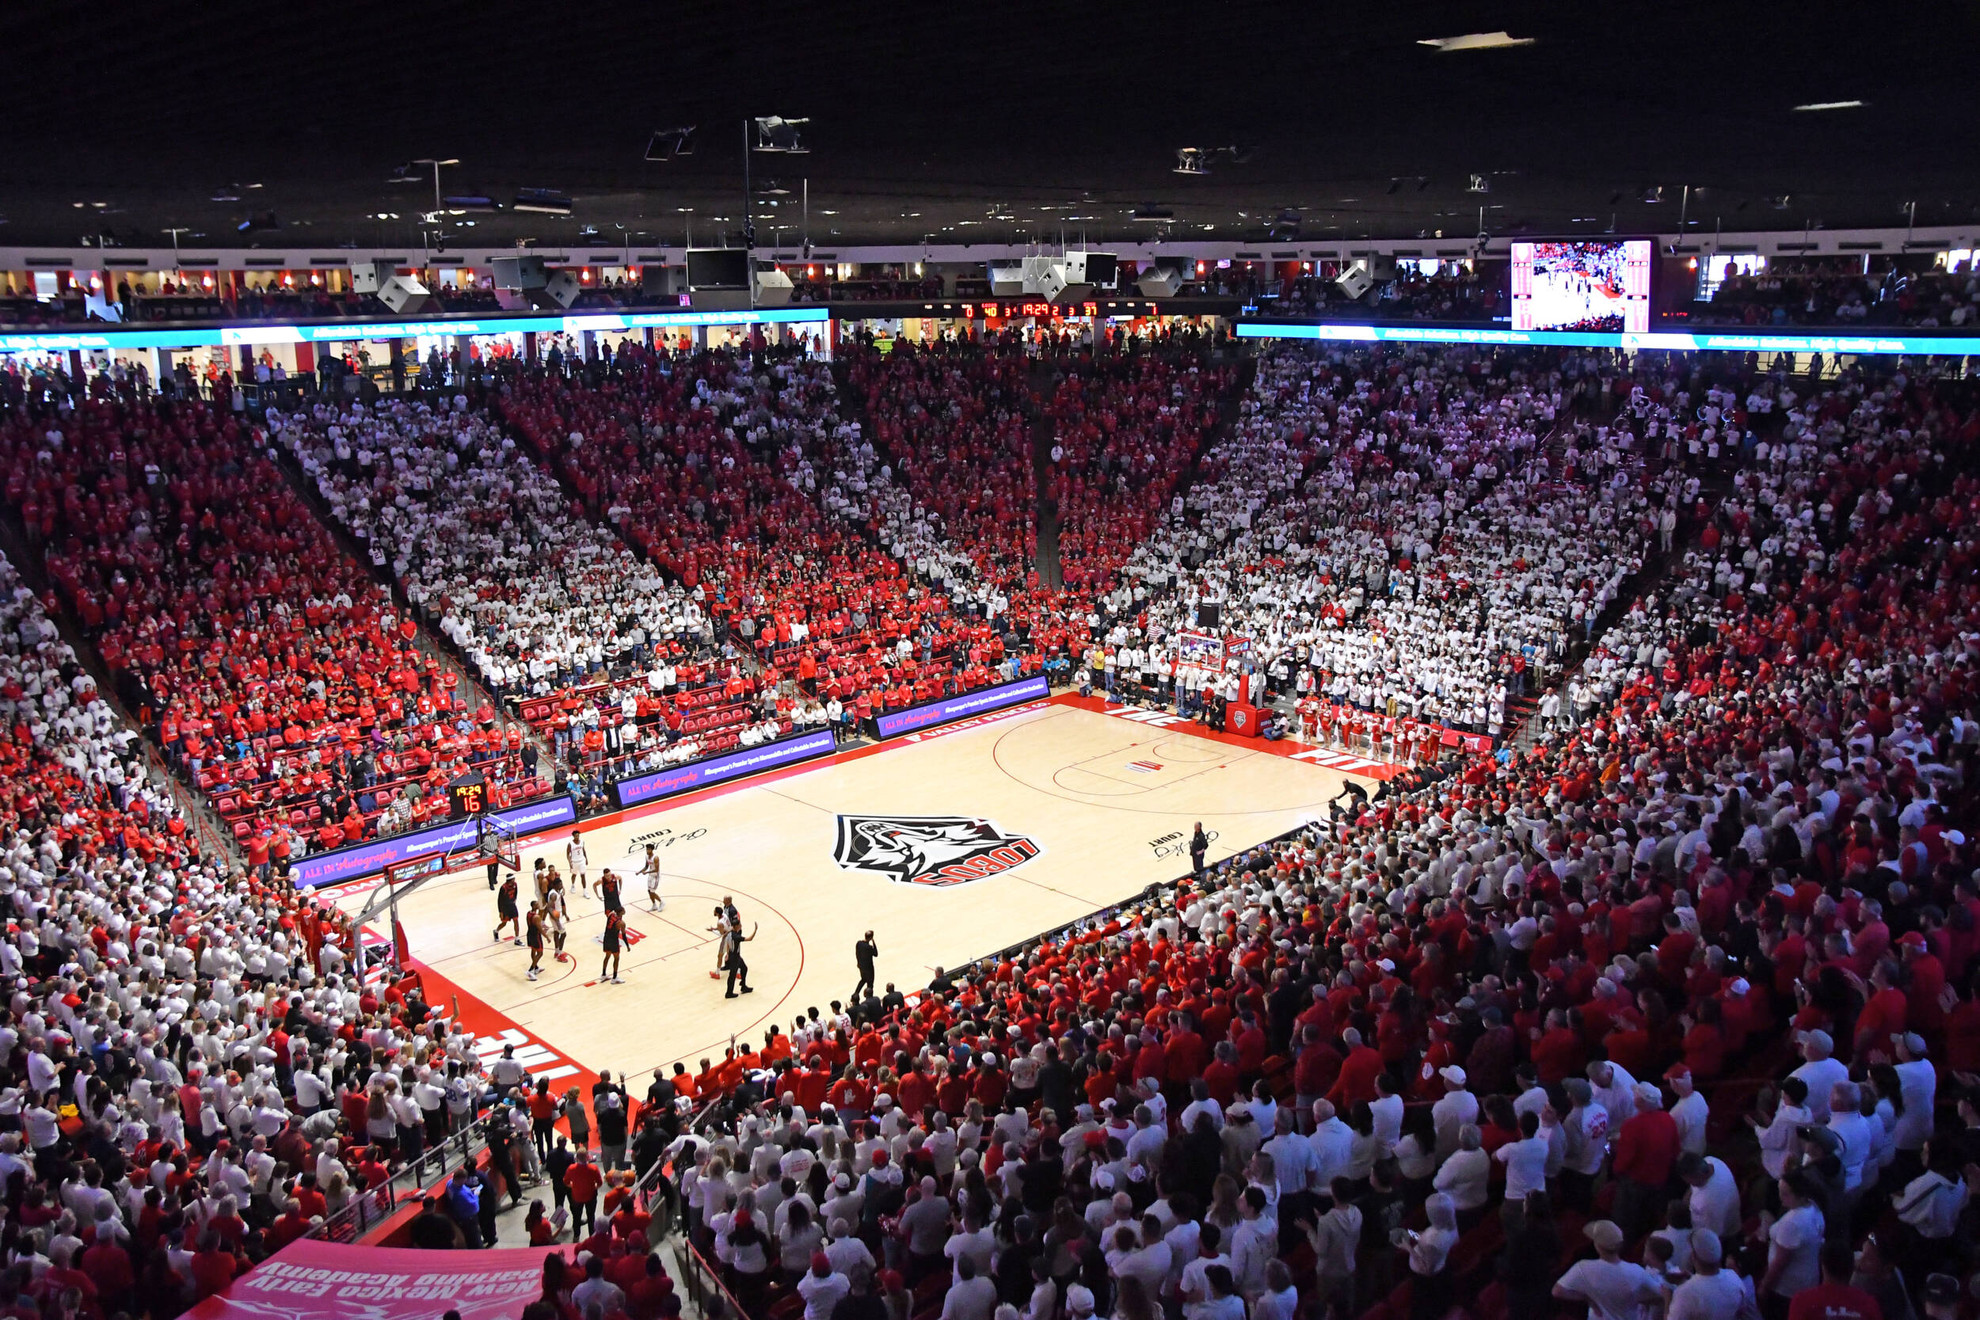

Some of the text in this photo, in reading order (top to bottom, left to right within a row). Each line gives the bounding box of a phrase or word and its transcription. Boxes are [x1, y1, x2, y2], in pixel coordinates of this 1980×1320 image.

[966, 308, 973, 318] 0
[984, 307, 998, 317] 40
[1004, 307, 1011, 317] 3
[1022, 303, 1049, 316] 19:29
[1085, 306, 1097, 316] 37
[923, 719, 981, 738] VALLEY
[982, 705, 1033, 722] FENCE
[1103, 705, 1385, 771] THE PIT
[456, 784, 482, 797] 19:29
[628, 771, 698, 796] ALL IN Autographs
[464, 796, 480, 813] 16
[630, 828, 672, 844] COURT
[1148, 831, 1184, 847] COURT
[304, 848, 397, 879] ALL IN Autographs
[911, 838, 1039, 887] LOBOS
[344, 877, 386, 895] BAN
[255, 1261, 411, 1287] Academy
[246, 1275, 539, 1301] New Mexico Early
